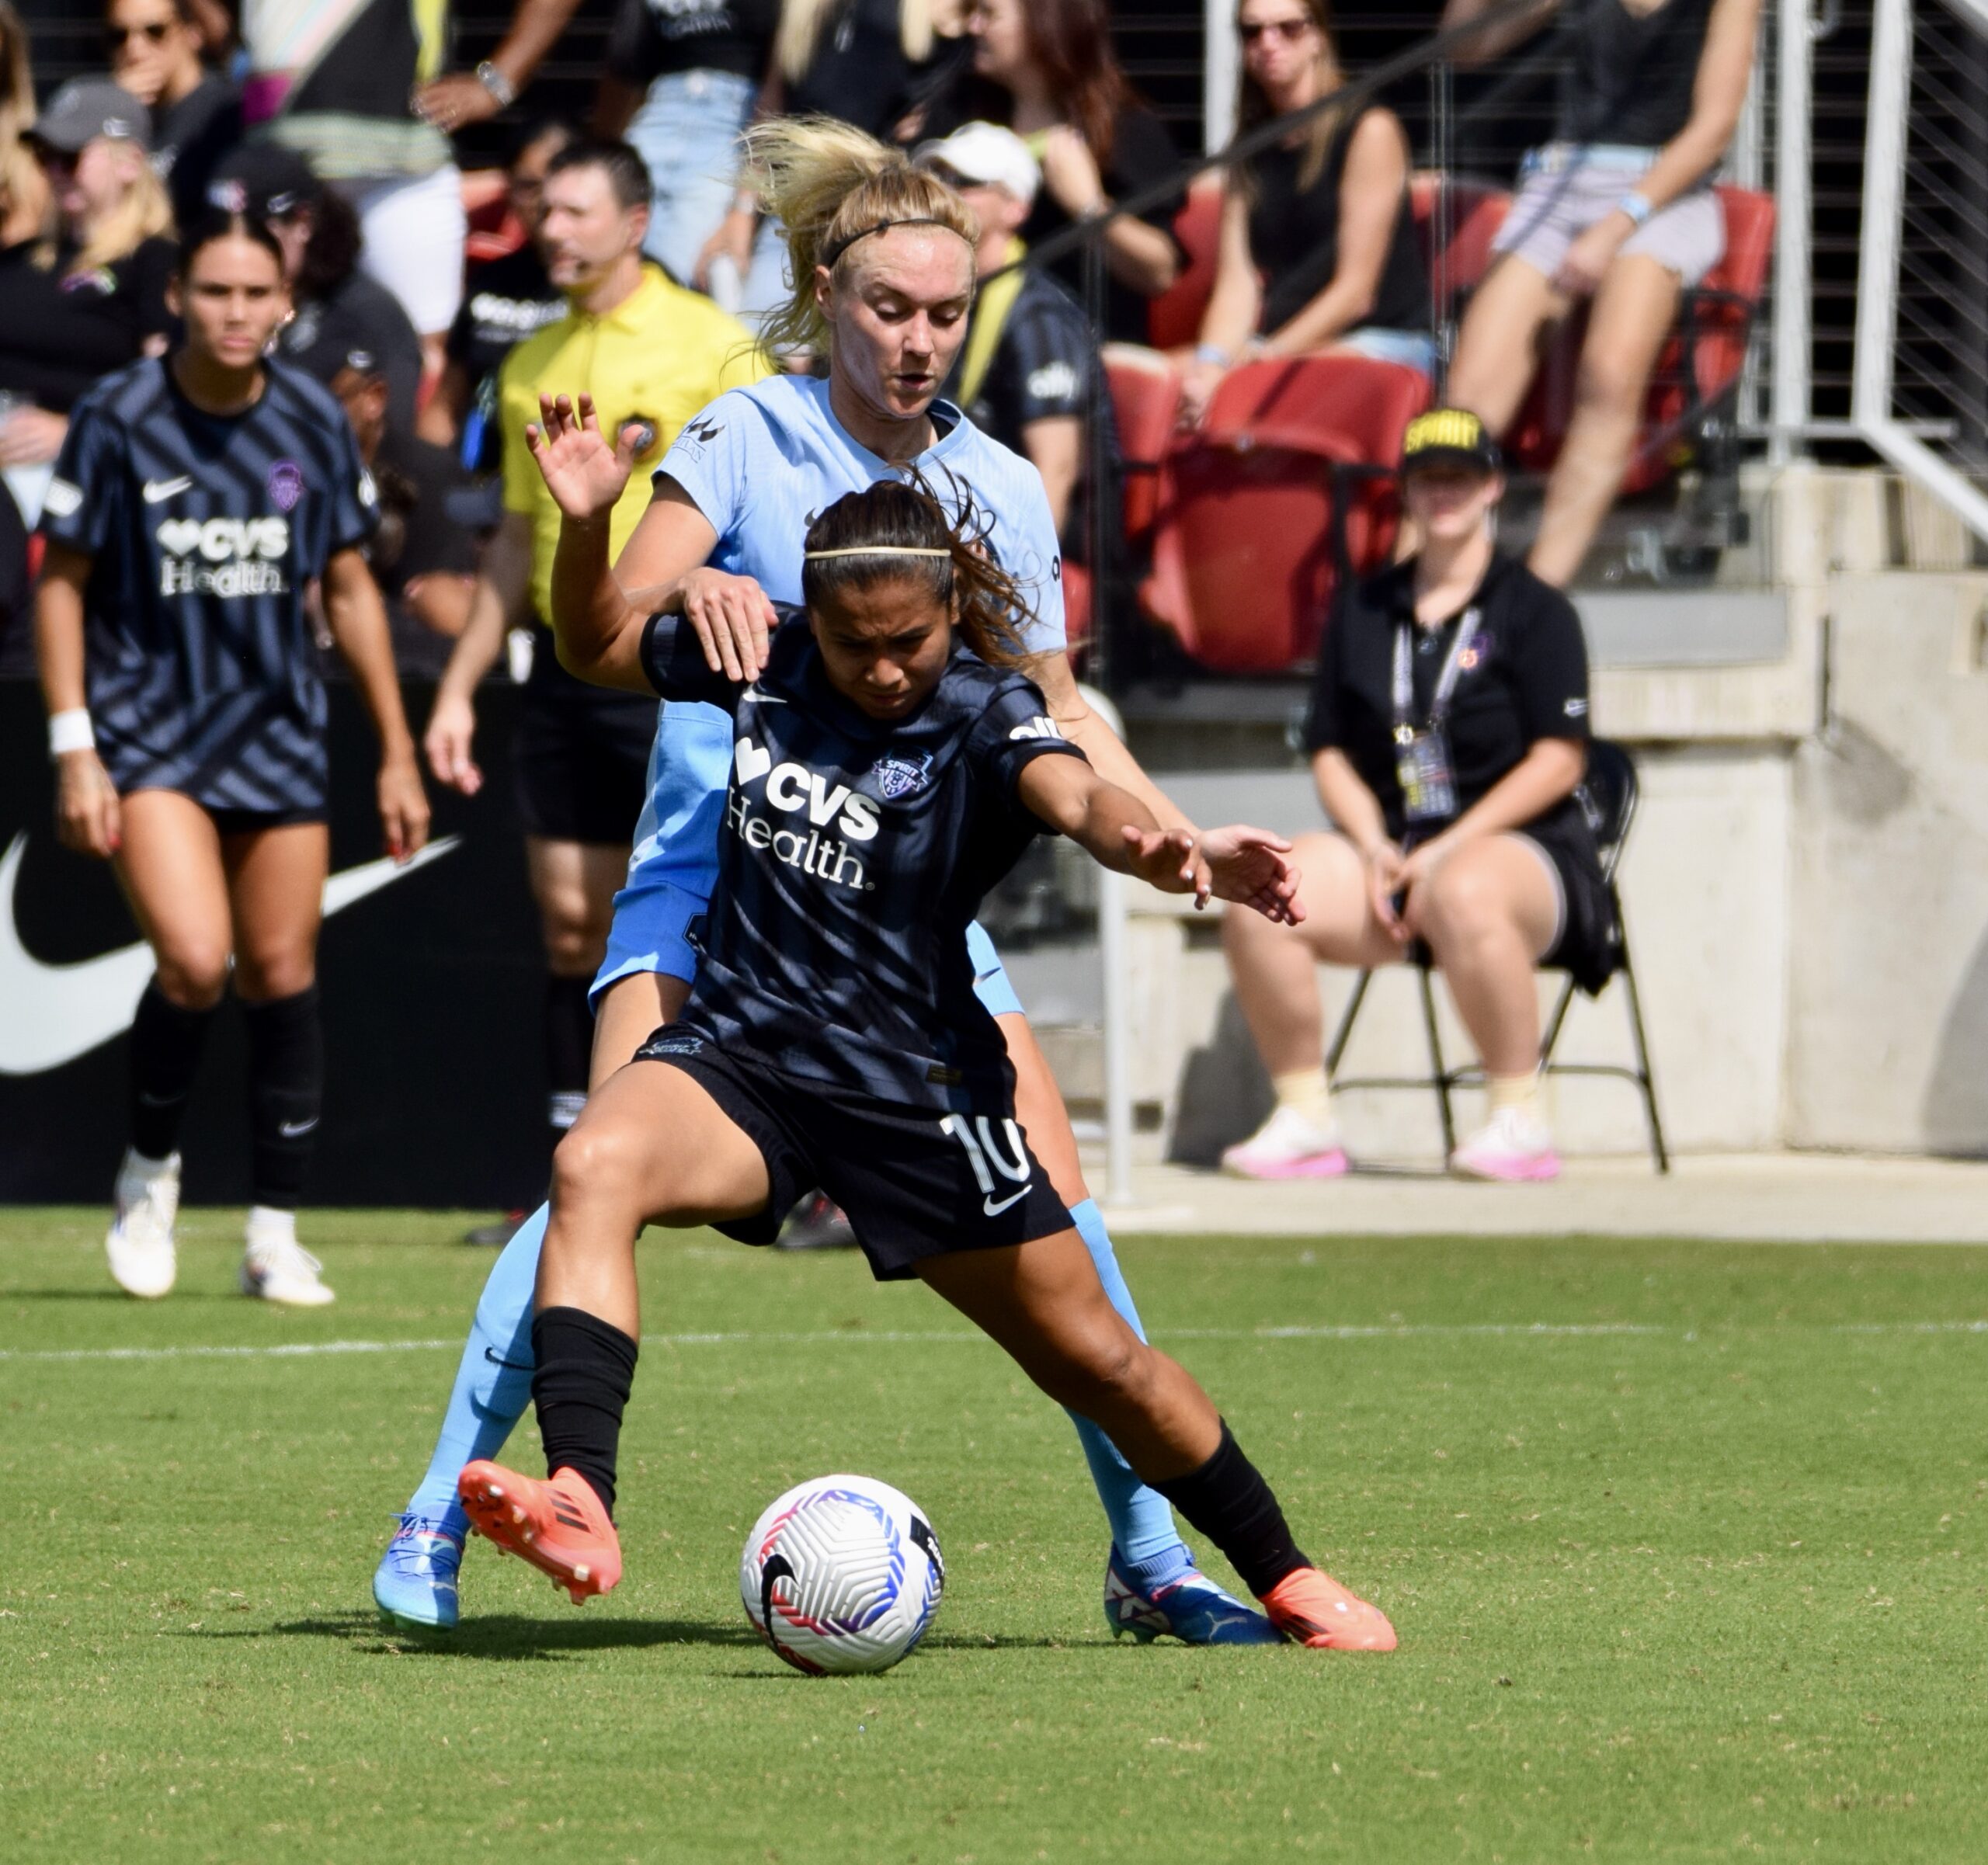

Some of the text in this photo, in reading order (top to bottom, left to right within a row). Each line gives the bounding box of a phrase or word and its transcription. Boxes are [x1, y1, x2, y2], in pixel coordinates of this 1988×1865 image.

[199, 517, 289, 561] CVS
[162, 556, 282, 598] Health
[887, 759, 919, 777] SPIRIT
[766, 762, 881, 841] CVS
[727, 785, 864, 889] Health
[940, 1113, 1030, 1193] 10
